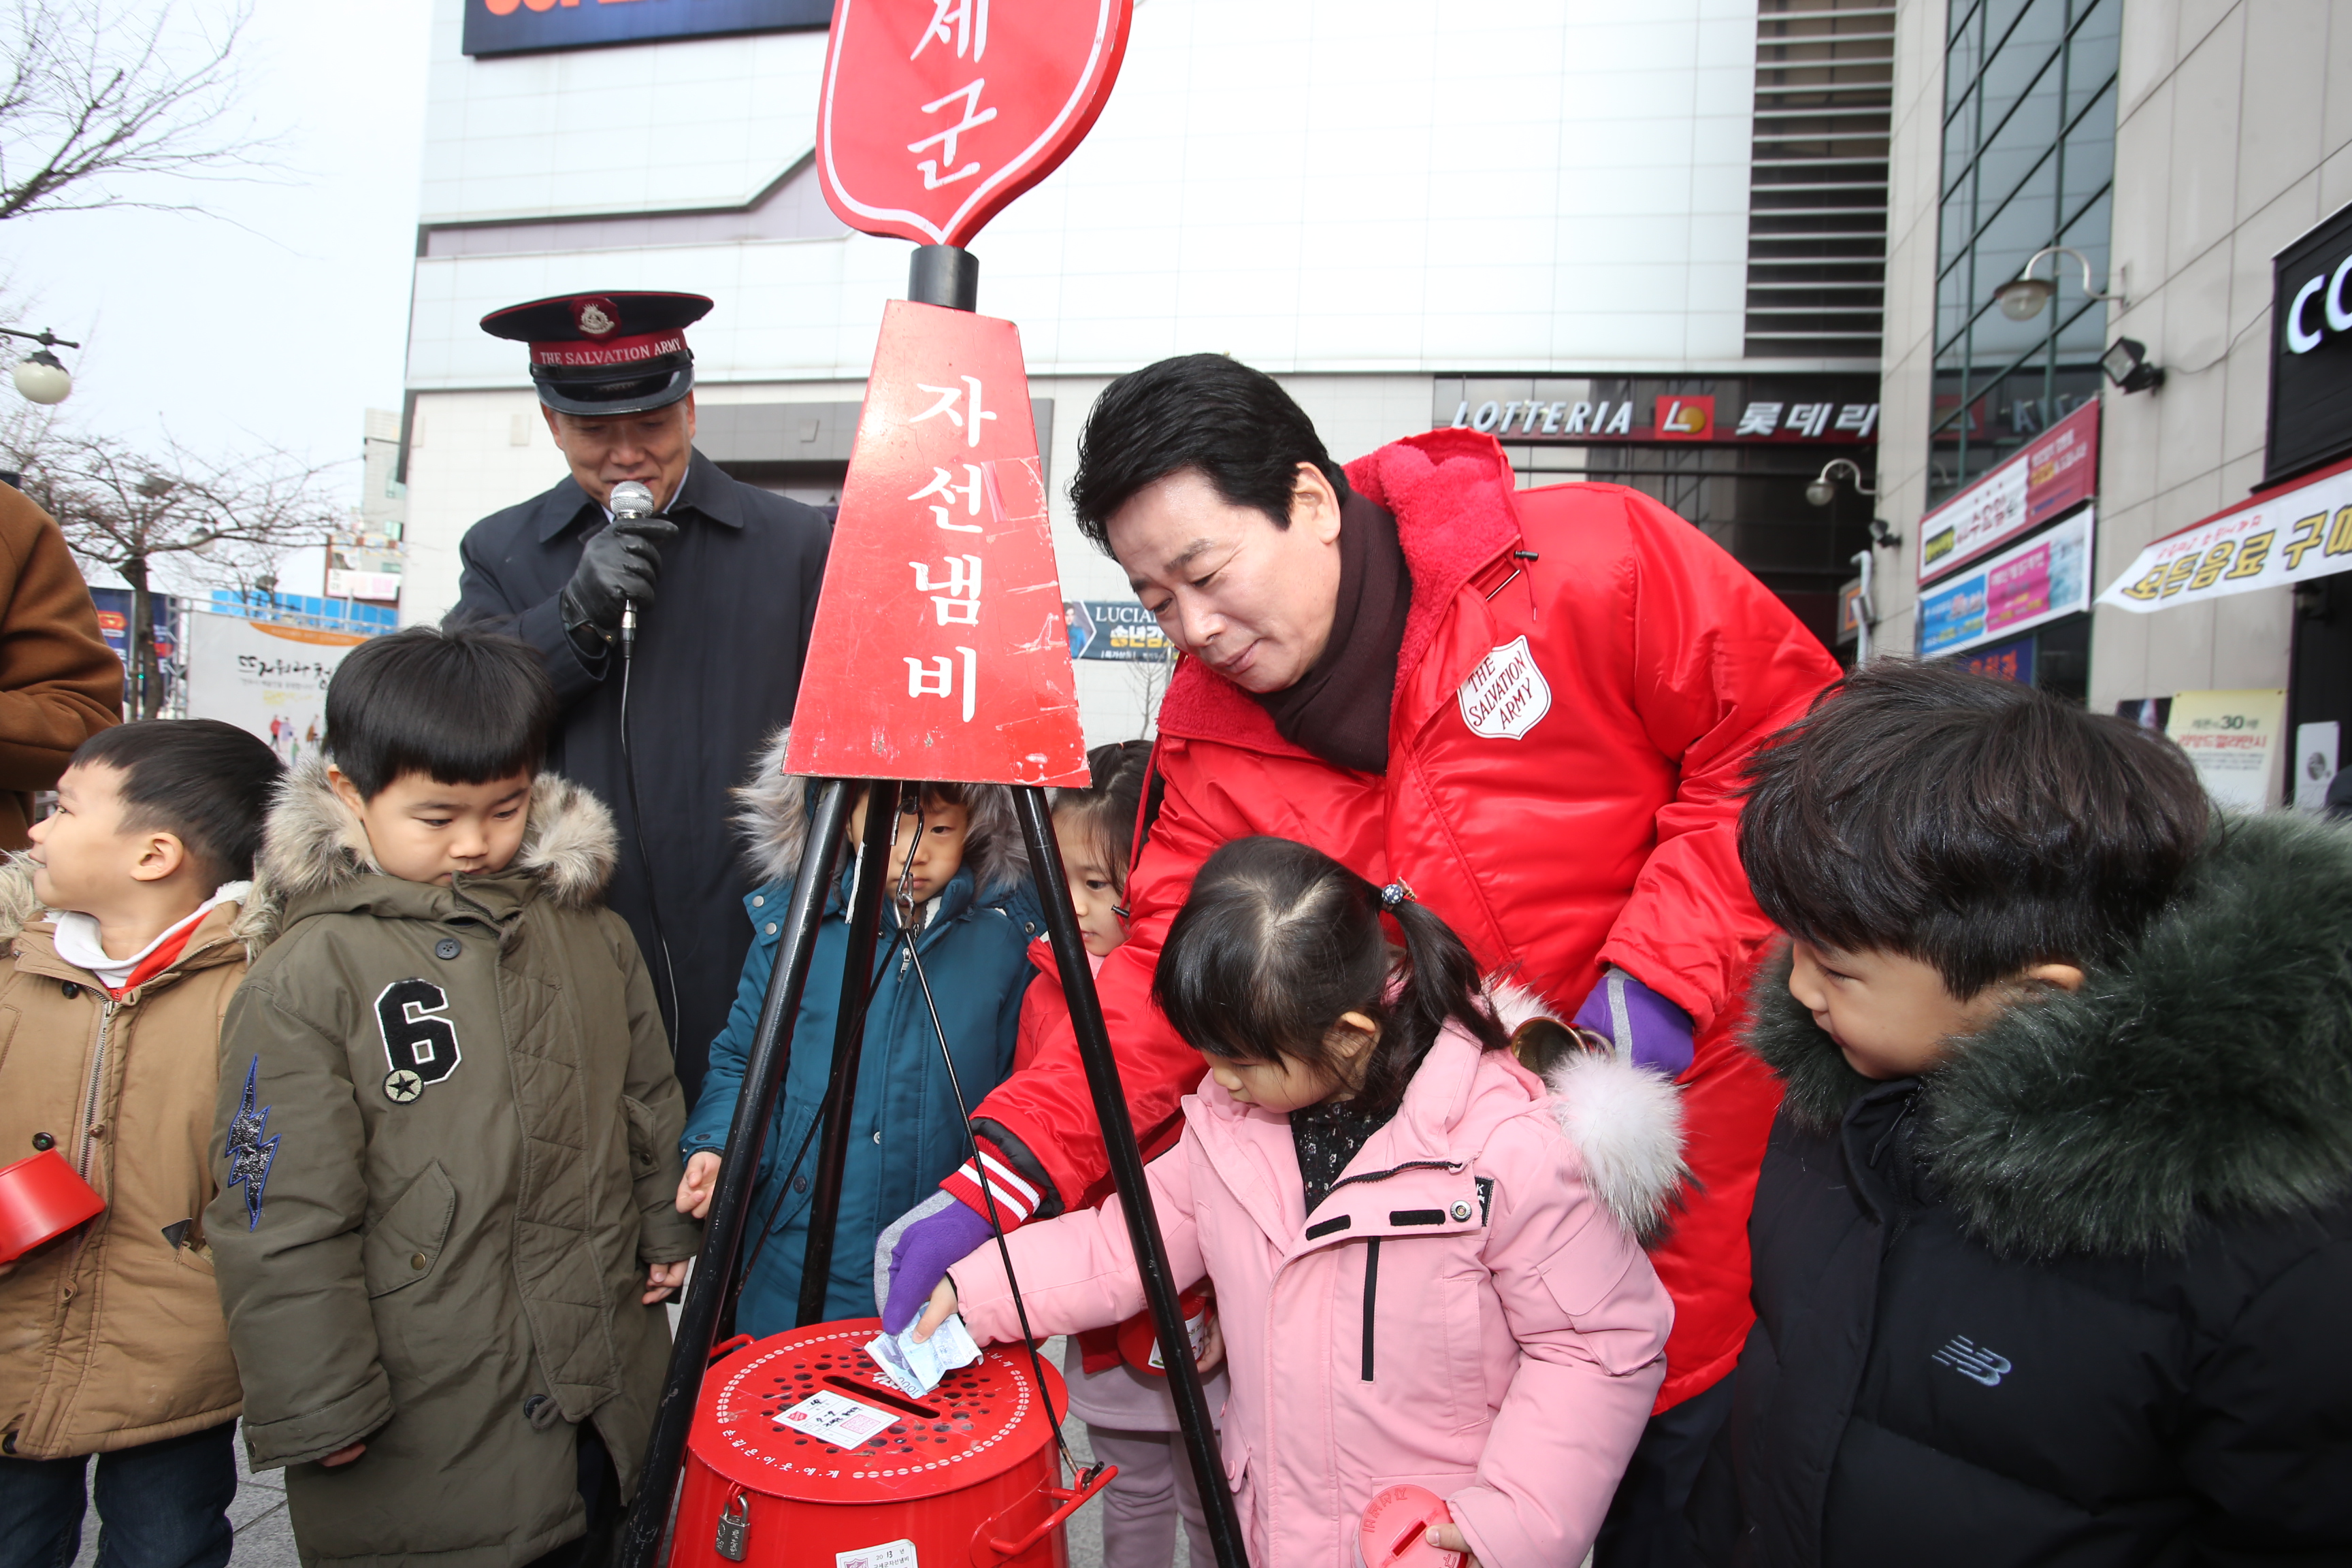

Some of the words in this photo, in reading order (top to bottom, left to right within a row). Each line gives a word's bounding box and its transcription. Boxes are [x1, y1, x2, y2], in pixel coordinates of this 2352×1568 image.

[540, 351, 562, 365] THE
[565, 345, 651, 365] SALVATION
[653, 337, 682, 357] ARMY
[1450, 400, 1633, 436] LOTTERIA
[1735, 402, 1880, 438] 롯데리
[902, 374, 998, 723] 자선냄비
[1095, 606, 1158, 623] LUCIA
[1467, 656, 1496, 694] THE
[1469, 650, 1527, 727] SALVATION
[1499, 677, 1533, 731] ARMY
[373, 977, 463, 1089] 6
